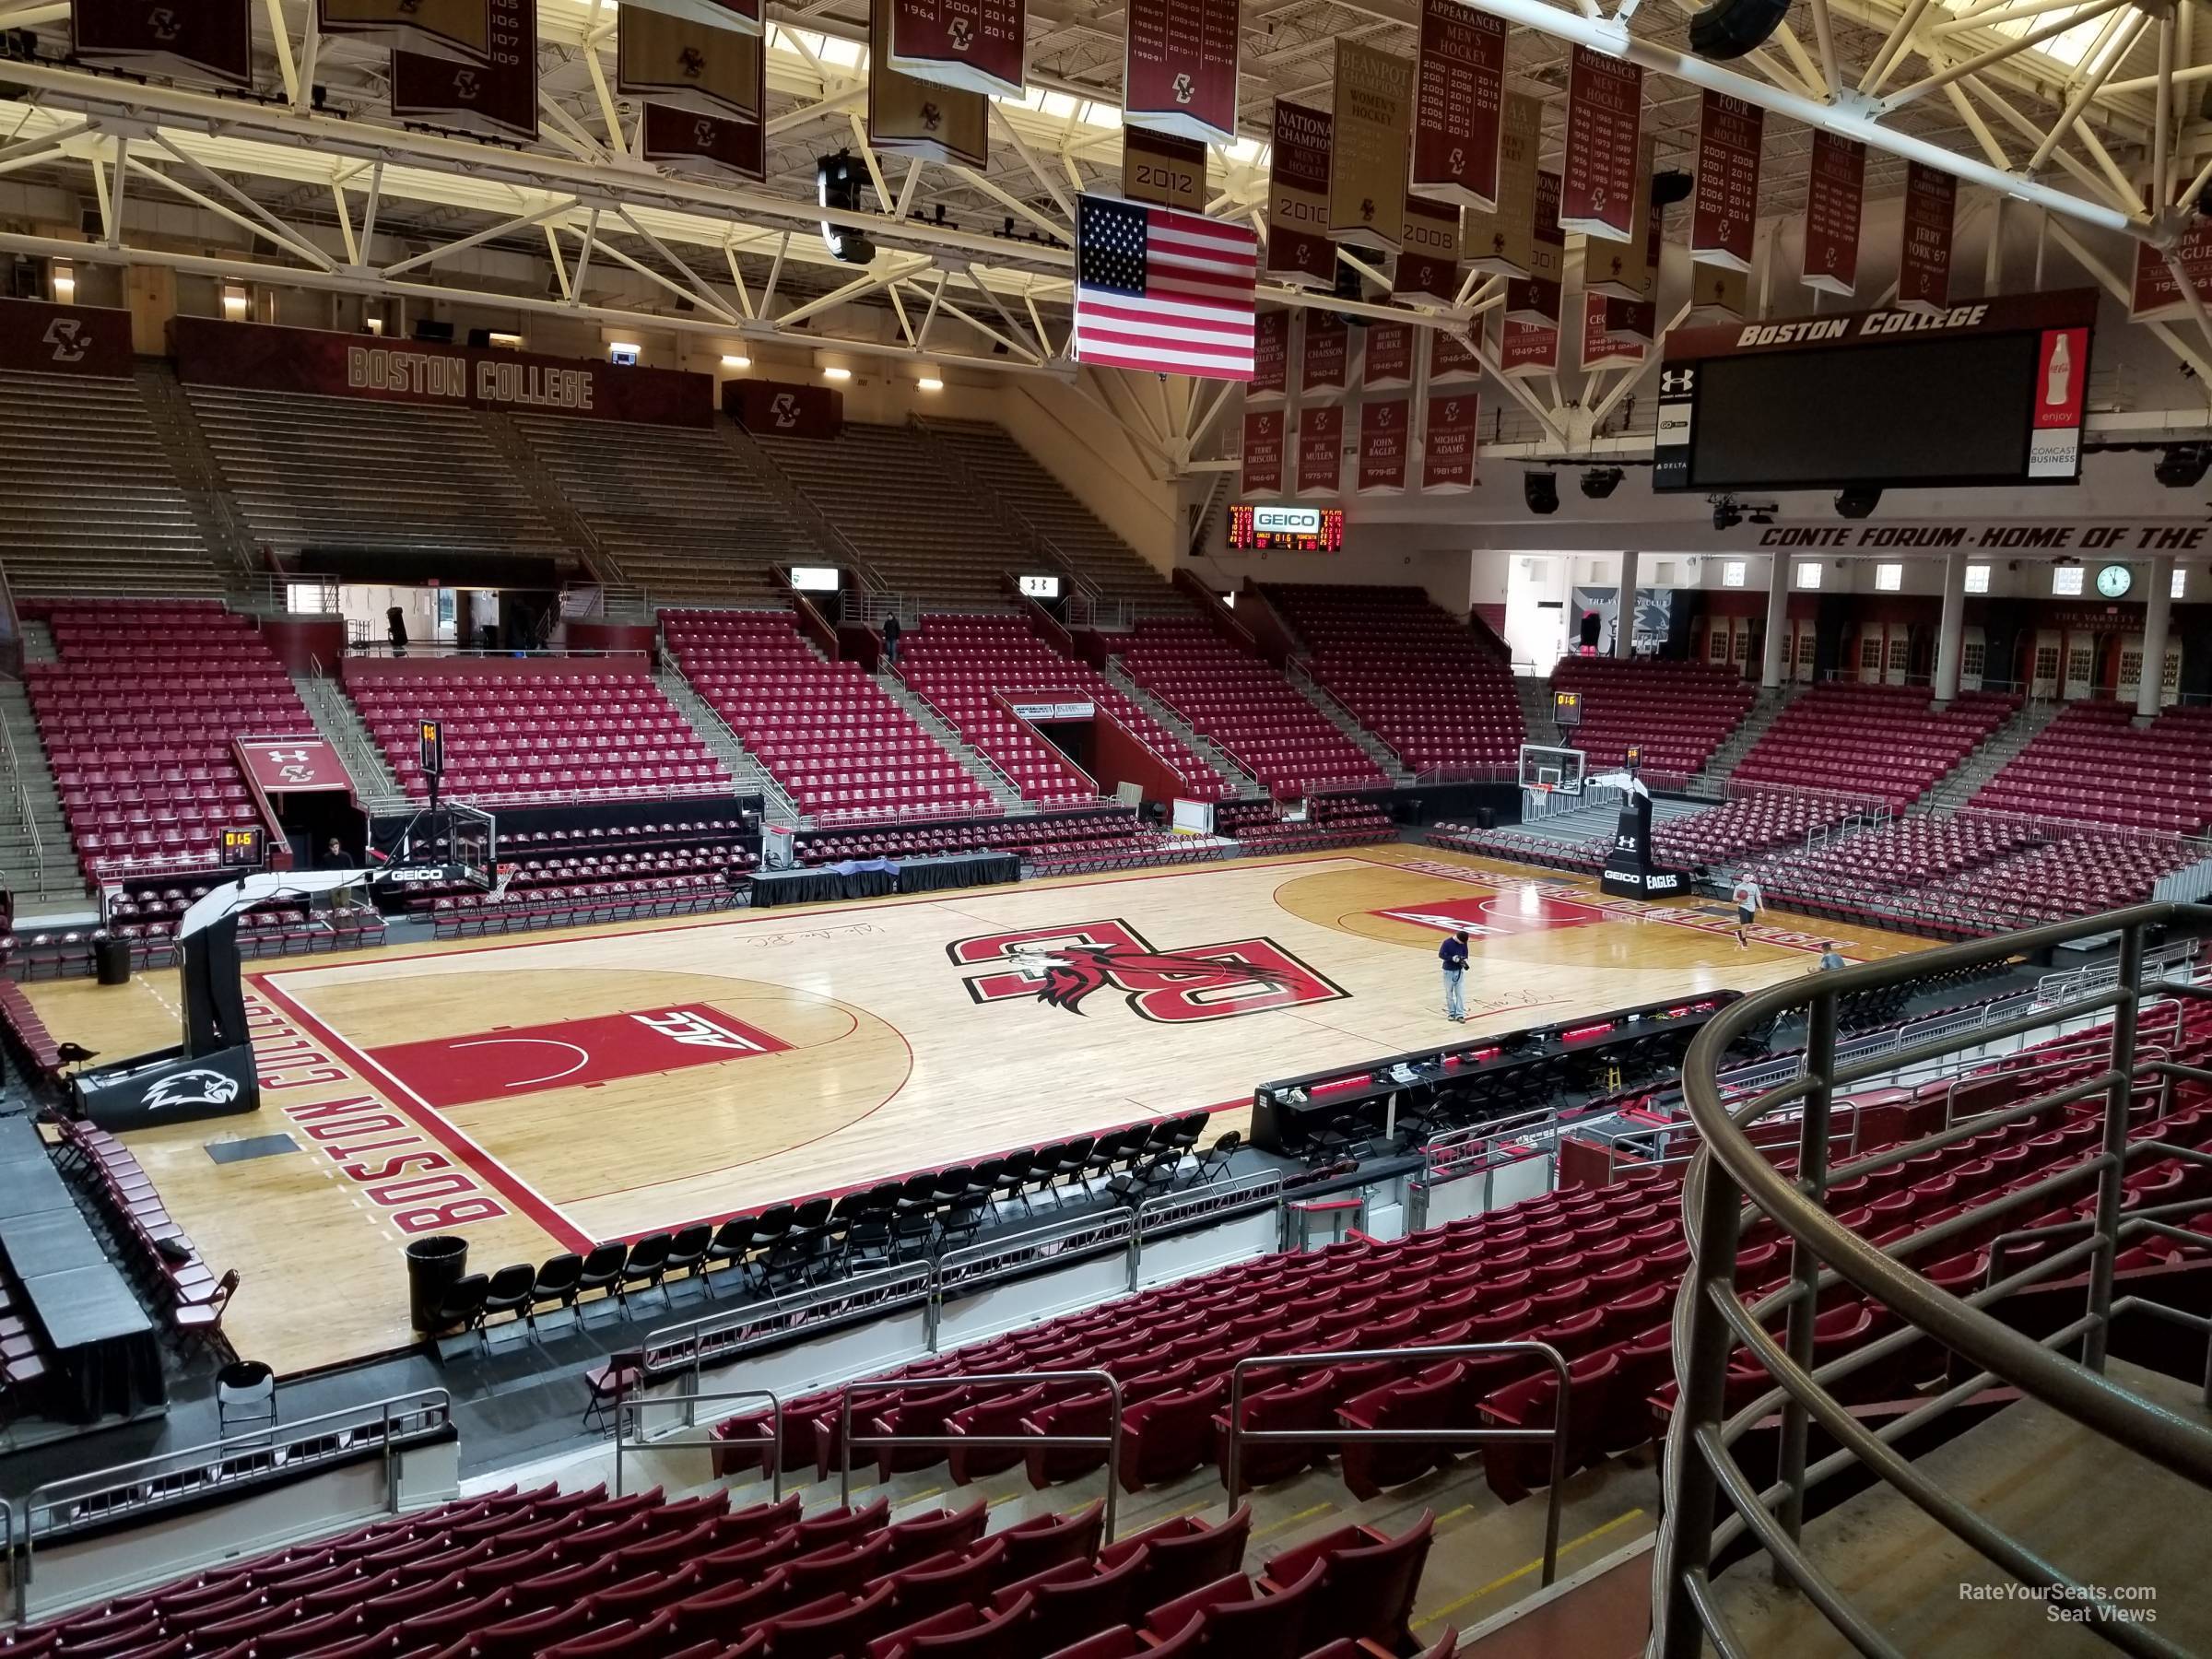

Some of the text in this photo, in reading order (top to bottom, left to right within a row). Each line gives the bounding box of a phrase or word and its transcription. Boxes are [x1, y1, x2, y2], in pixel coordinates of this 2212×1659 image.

[903, 4, 935, 21] 1964
[945, 0, 978, 16] 2004
[984, 9, 1016, 24] 2014
[1430, 0, 1500, 32] APPEARANCES
[984, 26, 1015, 41] 2016
[1446, 24, 1482, 46] MEN'S
[1440, 39, 1487, 65] HOCKEY
[1341, 50, 1410, 86] BEANPOT
[1423, 60, 1446, 73] 2000
[1580, 51, 1637, 81] APPEARANCES
[1423, 72, 1444, 84] 2001
[1451, 68, 1473, 80] 2007
[1451, 80, 1472, 92] 2008
[1477, 76, 1500, 88] 2014
[1422, 84, 1444, 96] 2003
[1477, 88, 1498, 100] 2015
[1421, 95, 1444, 107] 2004
[1450, 91, 1472, 103] 2010
[1449, 102, 1469, 114] 2011
[1477, 99, 1498, 111] 2016
[1718, 95, 1748, 117] FOUR
[1420, 107, 1443, 119] 2005
[1278, 109, 1333, 135] NATIONA
[1420, 119, 1442, 130] 2006
[1448, 114, 1470, 126] 2012
[1277, 127, 1333, 150] CHAMPION
[1448, 126, 1469, 138] 2013
[1703, 146, 1726, 159] 2000
[1702, 159, 1724, 172] 2001
[1732, 154, 1754, 168] 2008
[1135, 164, 1193, 194] 2012
[1701, 173, 1724, 186] 2004
[1731, 168, 1753, 182] 2010
[1700, 187, 1724, 201] 2006
[1730, 182, 1752, 195] 2012
[1700, 201, 1722, 214] 2007
[1729, 195, 1751, 208] 2014
[1728, 209, 1749, 222] 2016
[1404, 224, 1453, 250] 2008
[2183, 232, 2201, 245] IM
[1736, 304, 1989, 347] BOSTON COLLEGE
[1255, 353, 1274, 362] ELLEY
[1511, 346, 1547, 356] 1949-53
[347, 346, 593, 410] BOSTON COLLEGE
[2041, 411, 2073, 422] enjoy
[1373, 438, 1394, 448] JOHN
[1434, 434, 1466, 444] MICHAEL
[1369, 446, 1397, 457] BAGLEY
[1436, 443, 1465, 454] ADAMS
[2030, 446, 2076, 455] COMCAST
[1305, 451, 1334, 462] MULLEN
[2030, 454, 2075, 464] BUSINESS
[1258, 513, 1315, 527] GEICO
[1759, 527, 2209, 549] CONTE FORUM HOME OF THE
[1588, 597, 1605, 606] THE
[1646, 599, 1668, 607] CLUB
[391, 869, 443, 881] GEICO
[1604, 869, 1677, 889] GEICO EAGLES
[629, 1011, 759, 1051] ACC
[279, 1094, 512, 1236] BOSTON
